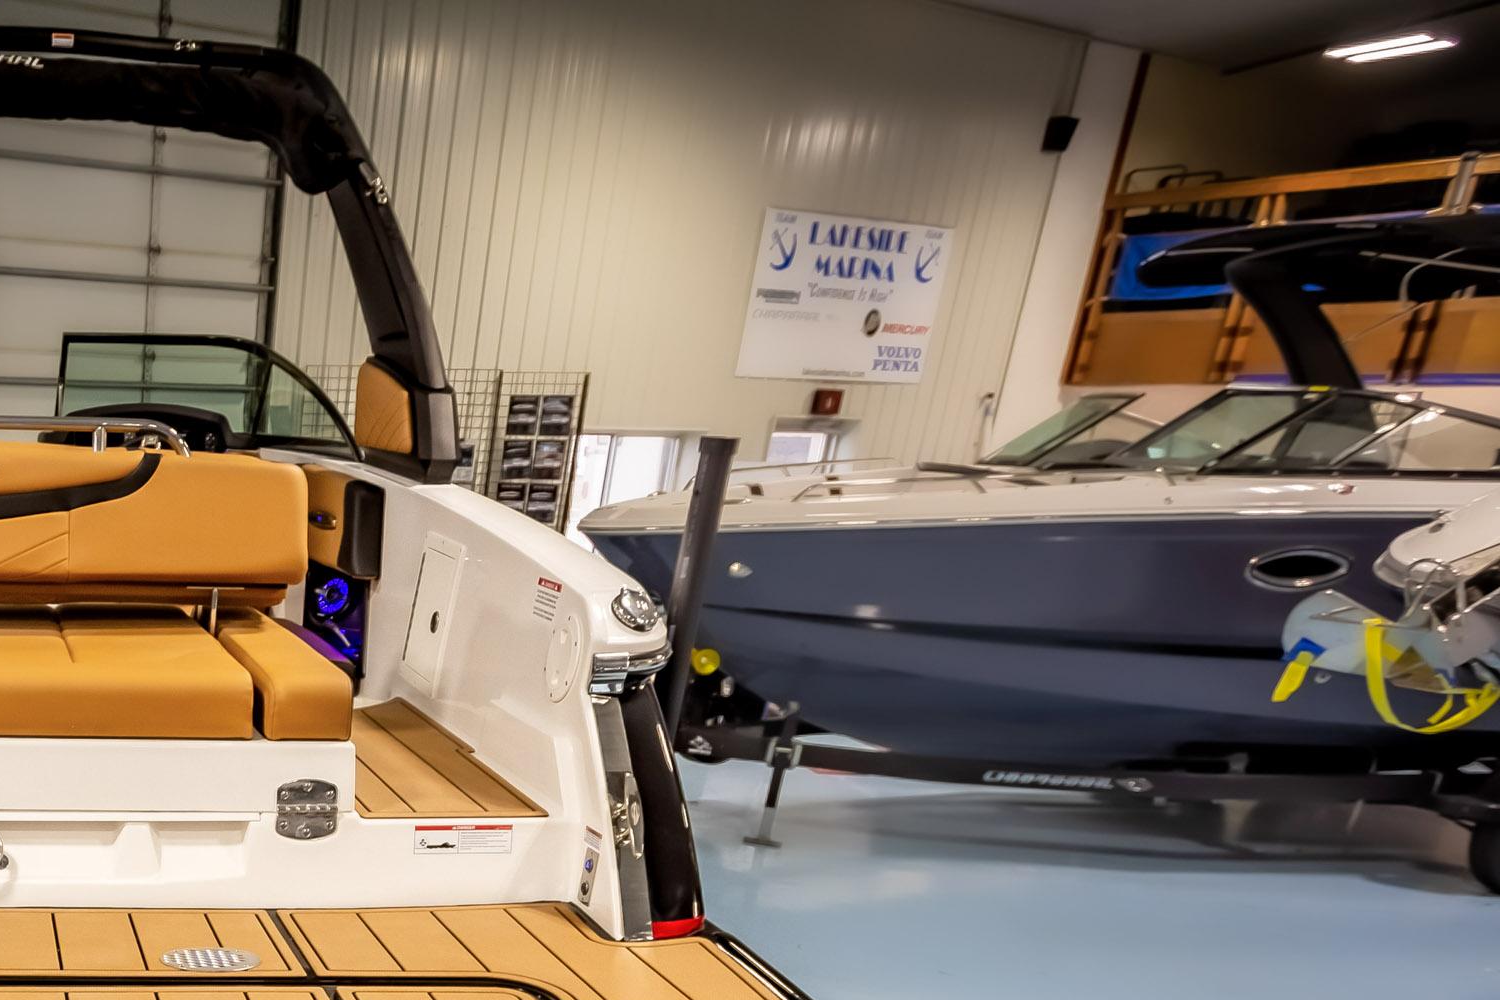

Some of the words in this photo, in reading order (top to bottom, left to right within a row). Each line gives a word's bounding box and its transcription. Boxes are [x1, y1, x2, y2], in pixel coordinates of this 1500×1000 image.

[808, 220, 910, 255] LAKESIDE
[815, 253, 896, 283] MARINA
[882, 323, 930, 335] MERCURY
[877, 345, 922, 359] VOLVO
[871, 359, 920, 373] PENTA
